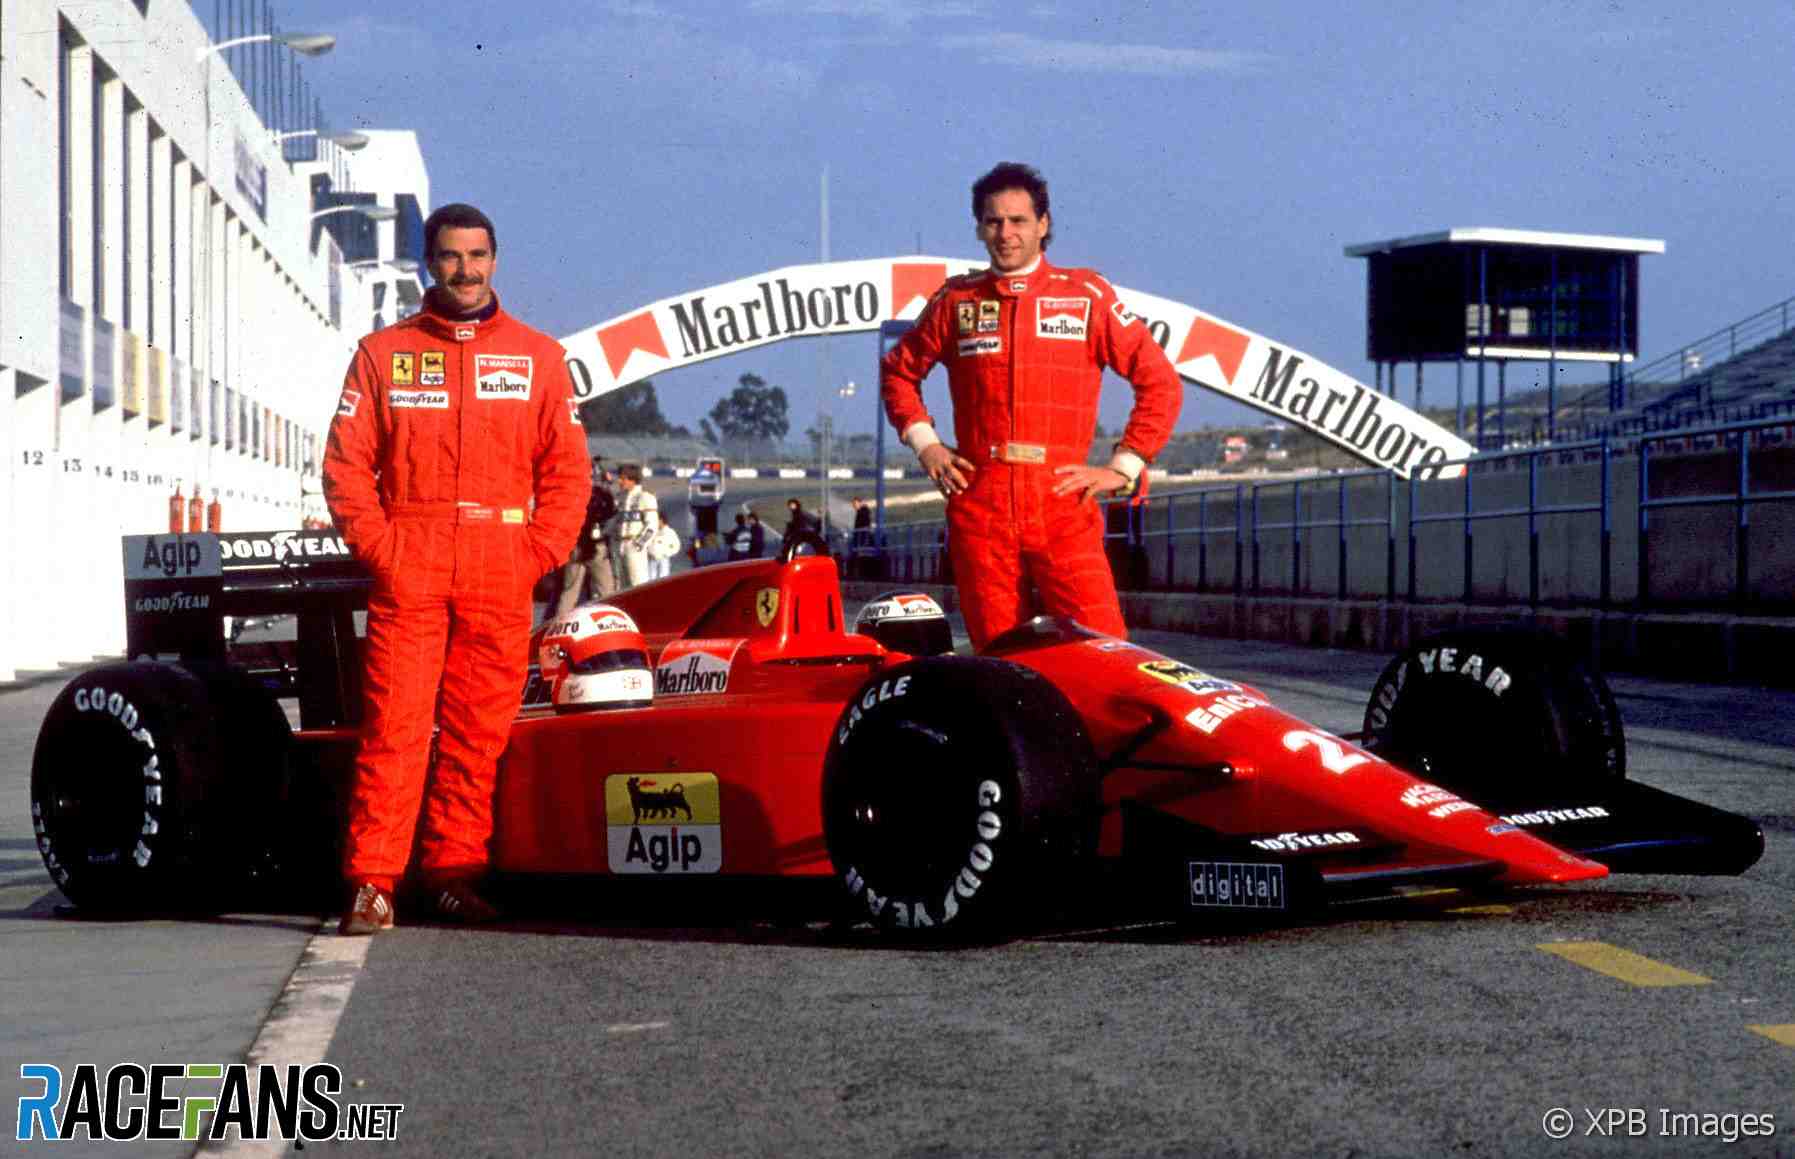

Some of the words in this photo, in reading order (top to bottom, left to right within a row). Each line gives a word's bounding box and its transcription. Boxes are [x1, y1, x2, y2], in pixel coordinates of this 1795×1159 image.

[669, 279, 880, 358] Marlboro
[480, 376, 527, 392] Marlboro
[1249, 346, 1448, 481] Marlboro
[23, 450, 44, 465] 12
[63, 458, 82, 472] 13
[95, 465, 113, 478] 14
[143, 535, 201, 576] Agip
[656, 655, 727, 693] Marlboro
[838, 675, 912, 745] EAGLE
[1282, 729, 1371, 775] 2
[625, 825, 702, 872] Agip
[1192, 873, 1278, 900] digital
